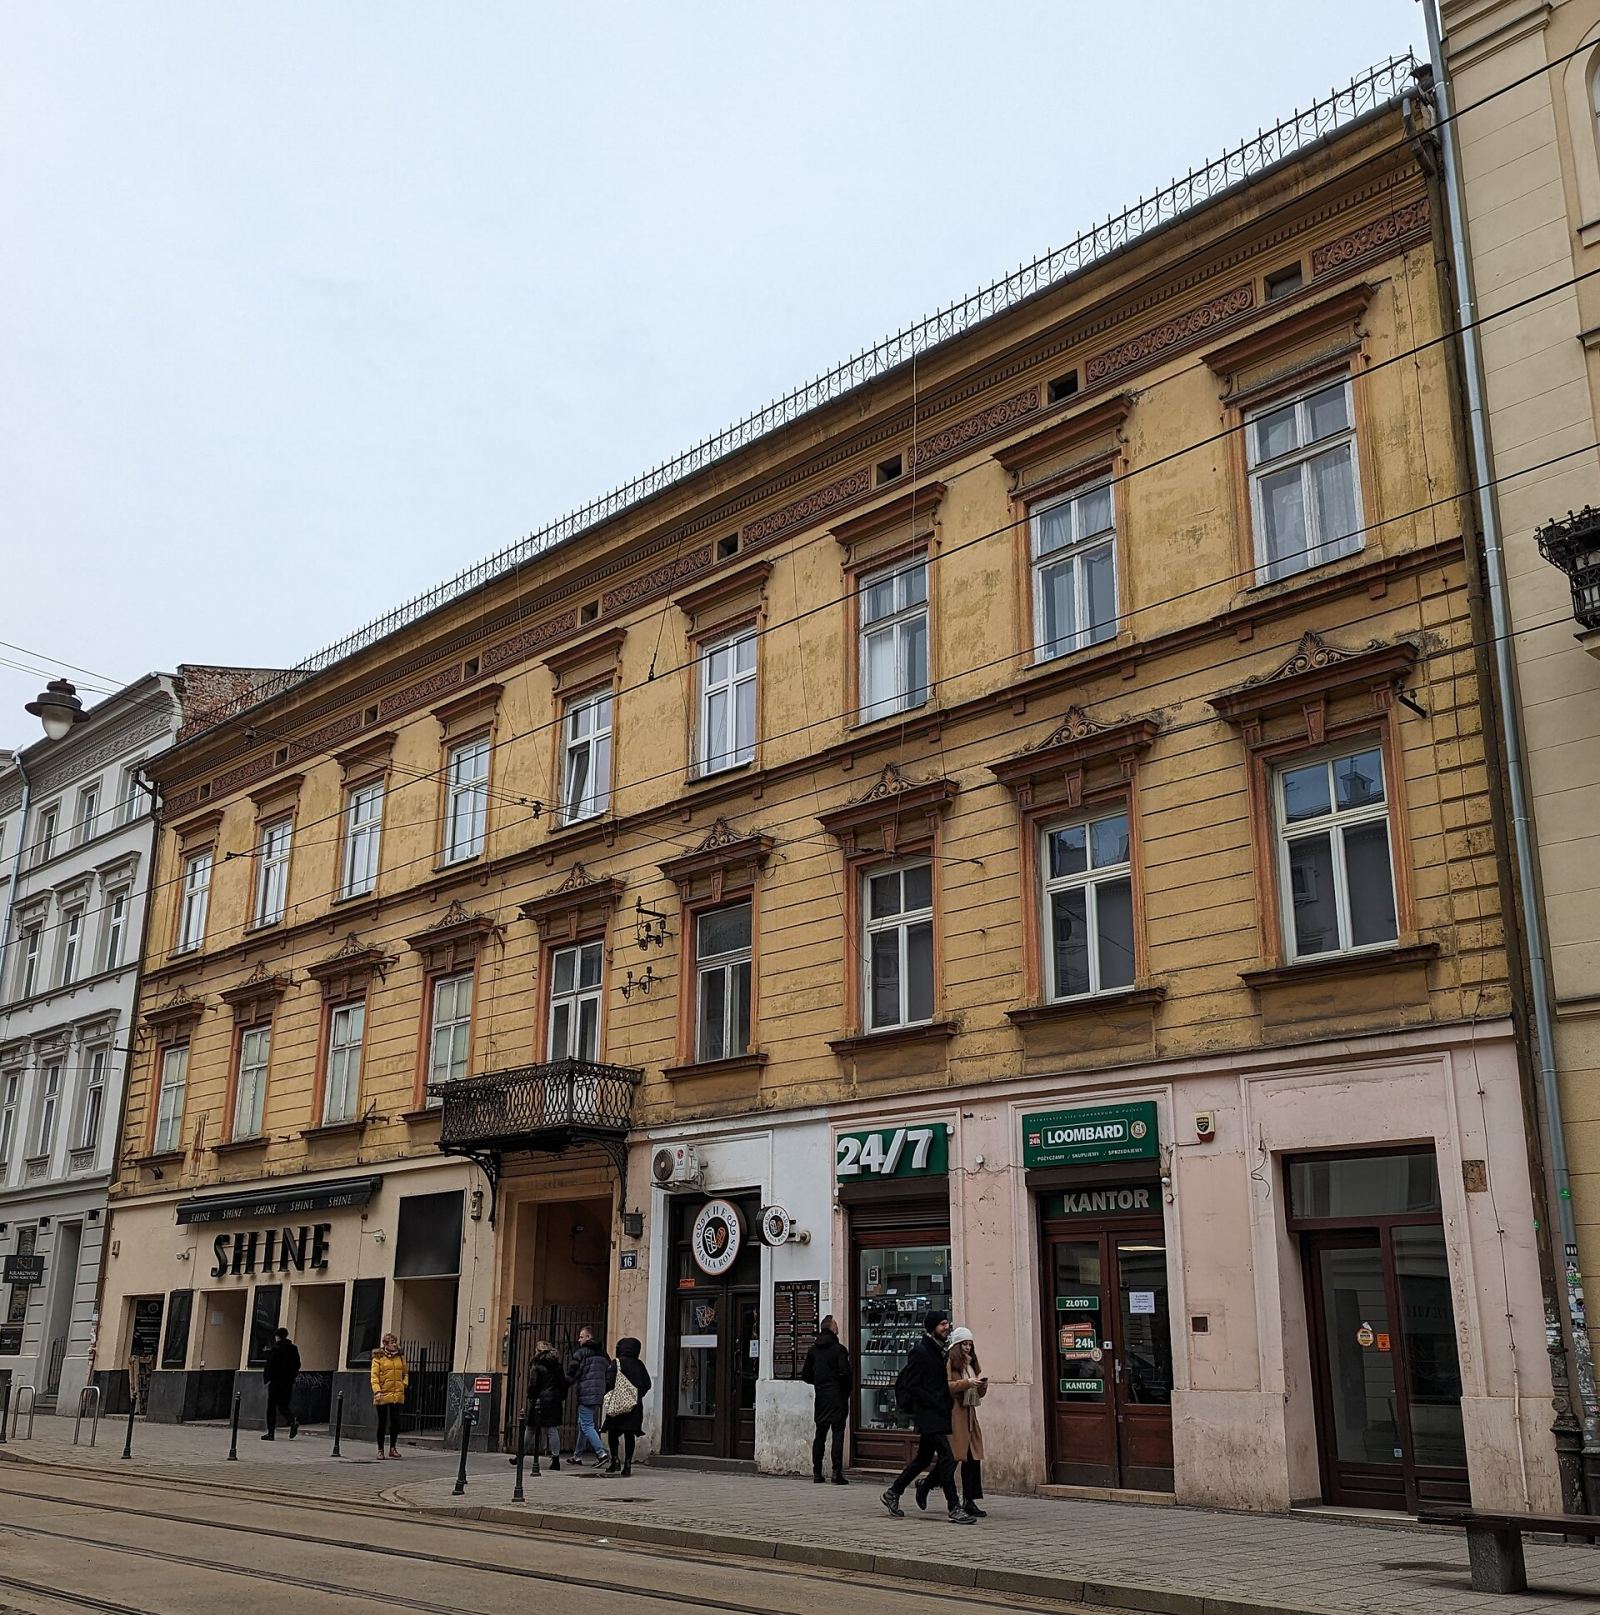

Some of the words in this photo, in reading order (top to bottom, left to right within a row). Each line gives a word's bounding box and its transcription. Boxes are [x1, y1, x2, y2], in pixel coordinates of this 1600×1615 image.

[1047, 1124, 1124, 1144] LOOMBARD
[836, 1128, 934, 1175] 24/7
[290, 1200, 314, 1211] SHINE
[328, 1195, 352, 1207] SHINE
[1064, 1188, 1149, 1213] KANTOR
[222, 1208, 243, 1219] SHINE
[254, 1204, 278, 1215] SHINE
[705, 1206, 727, 1218] THE
[190, 1212, 211, 1222] SHINE
[210, 1223, 331, 1278] SHINE
[696, 1242, 716, 1268] MASALA
[718, 1239, 735, 1267] ROLLS
[624, 1256, 632, 1267] 16
[1075, 1338, 1094, 1348] 24h
